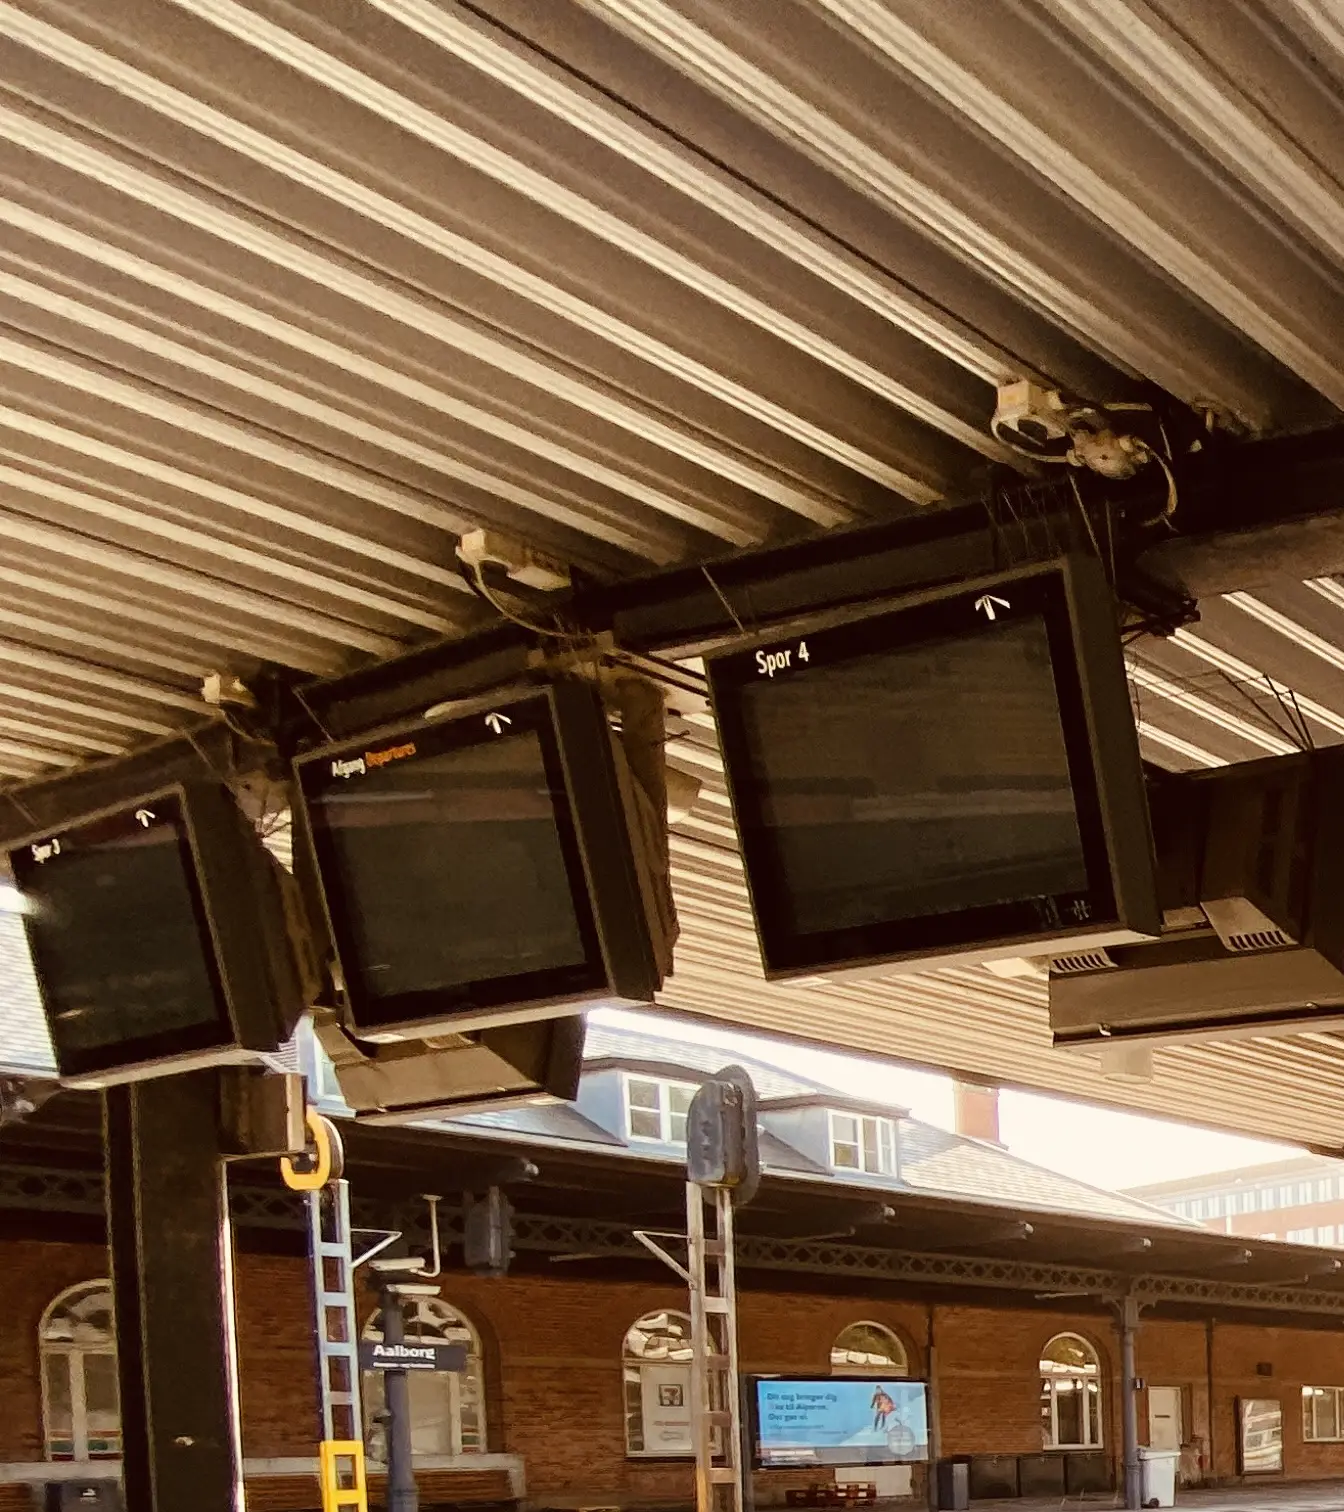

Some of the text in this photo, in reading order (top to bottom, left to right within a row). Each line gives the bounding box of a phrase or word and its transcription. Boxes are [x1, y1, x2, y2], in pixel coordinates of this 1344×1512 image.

[755, 641, 810, 678] Spor 4
[372, 1344, 436, 1360] Aalborg
